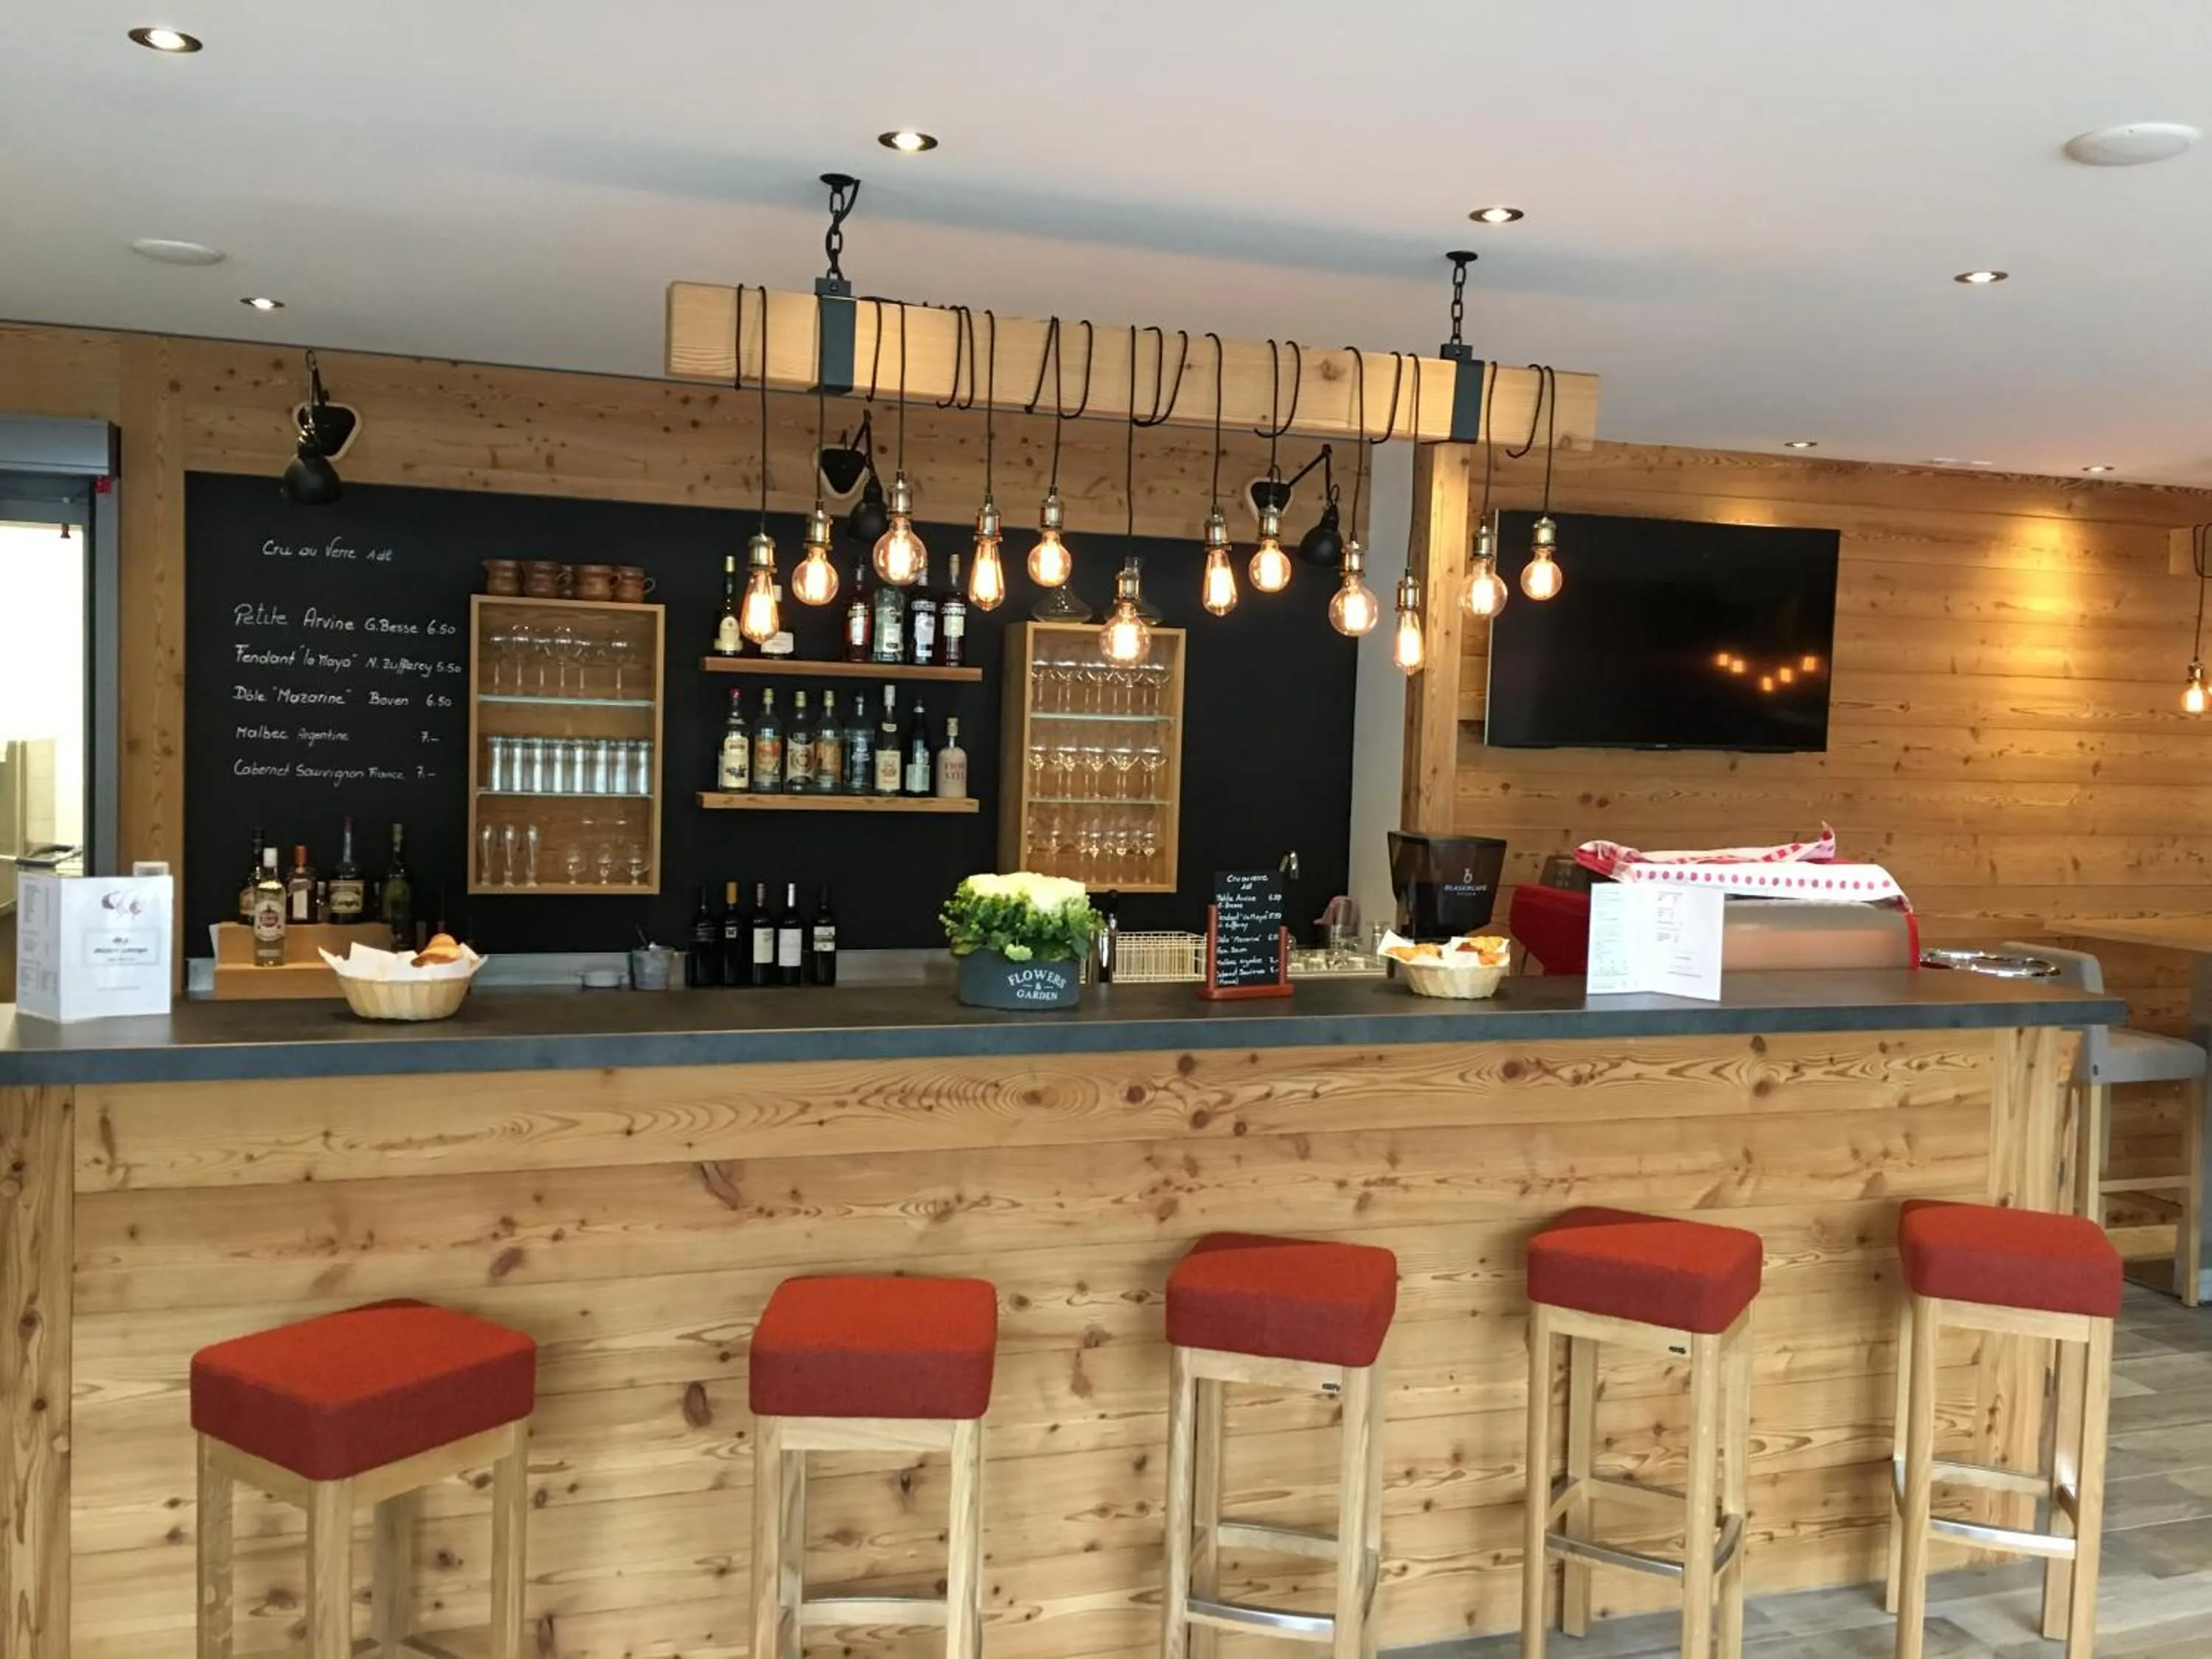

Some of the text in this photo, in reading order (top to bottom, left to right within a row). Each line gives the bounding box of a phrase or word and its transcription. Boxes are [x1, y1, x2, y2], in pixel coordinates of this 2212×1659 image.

[262, 540, 292, 555] Cru
[299, 546, 317, 557] au
[234, 603, 288, 625] Petite
[304, 608, 354, 630] Arvine
[427, 620, 456, 635] 6.50
[234, 644, 295, 665] Fendant
[425, 692, 453, 707] 6.50
[235, 725, 288, 740] Malbec
[297, 728, 349, 747] Argentine
[234, 759, 291, 776] Cabernet
[296, 764, 364, 787] Sauvignon
[1007, 968, 1067, 989] FLOWERS
[1016, 989, 1058, 1001] GARDEN
